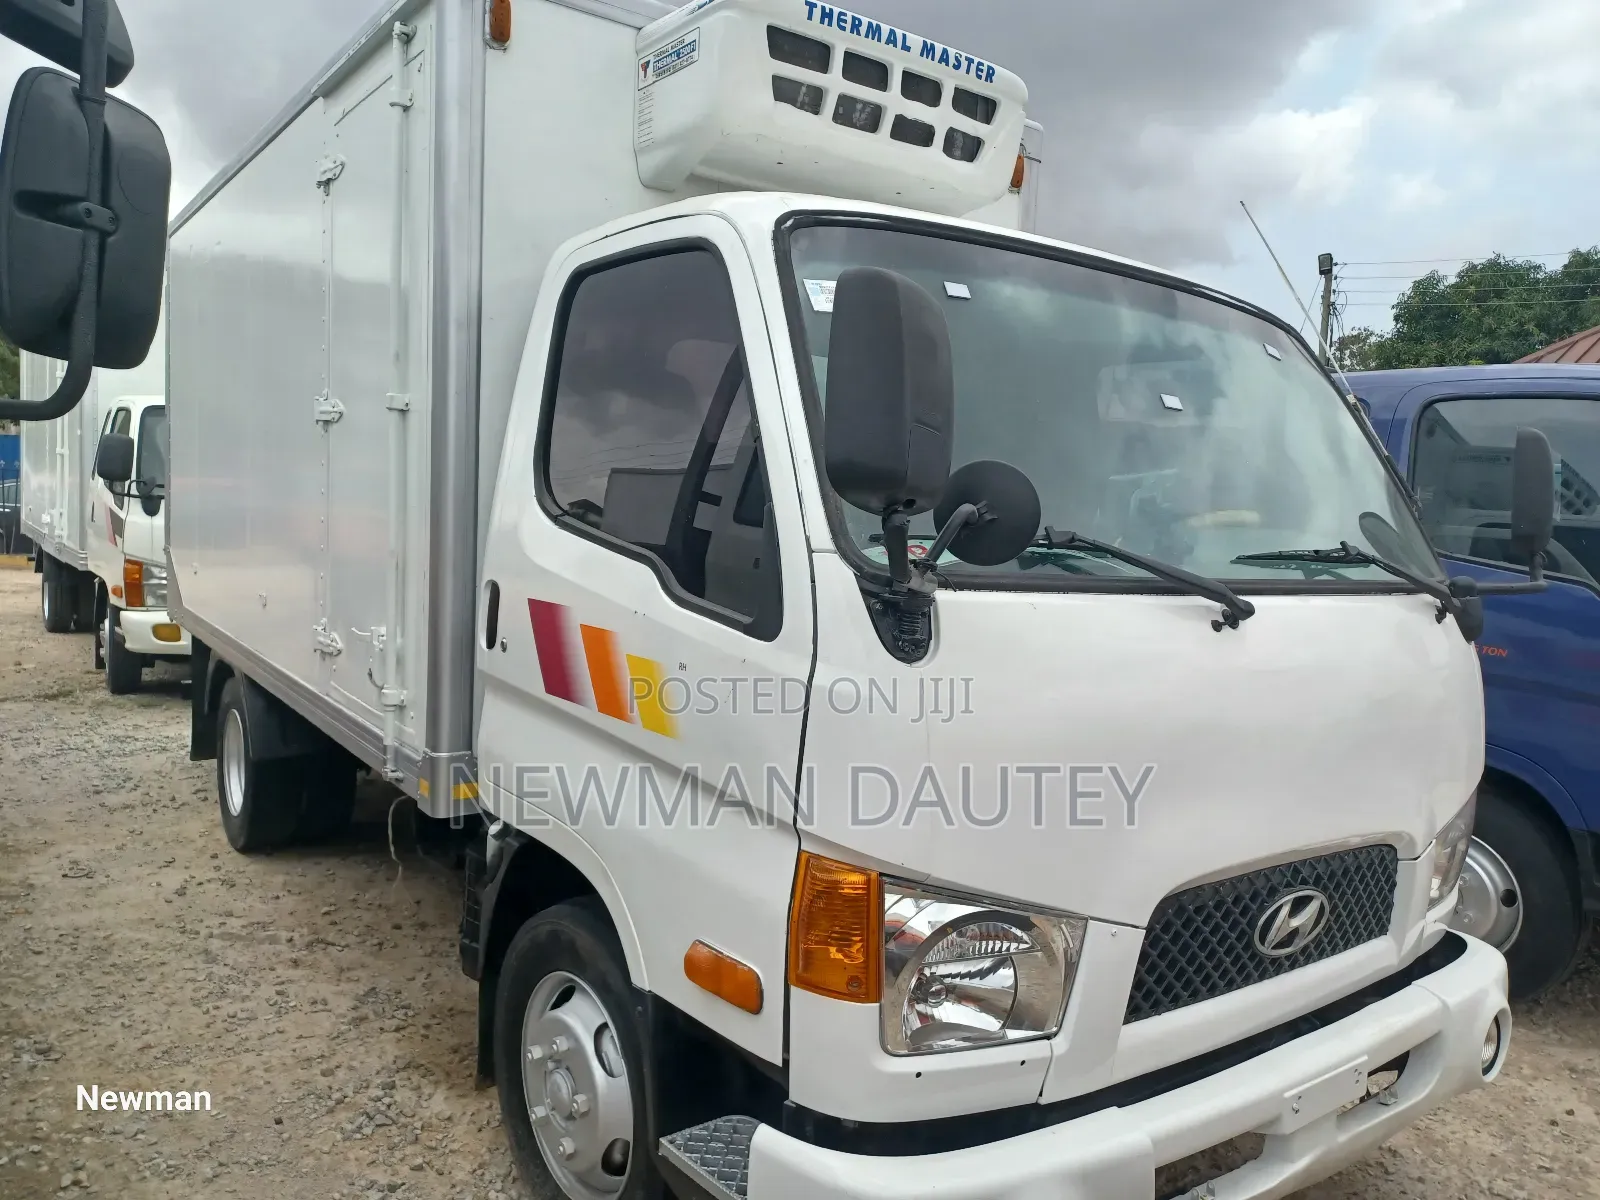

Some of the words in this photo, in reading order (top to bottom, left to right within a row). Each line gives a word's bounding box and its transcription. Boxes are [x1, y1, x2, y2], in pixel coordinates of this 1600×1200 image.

[653, 46, 670, 59] THERMAL
[670, 38, 685, 50] MASTER
[804, 0, 911, 53] THERMAL
[919, 39, 995, 83] MASTER
[653, 52, 678, 71] THERMAL
[1482, 645, 1508, 657] TON
